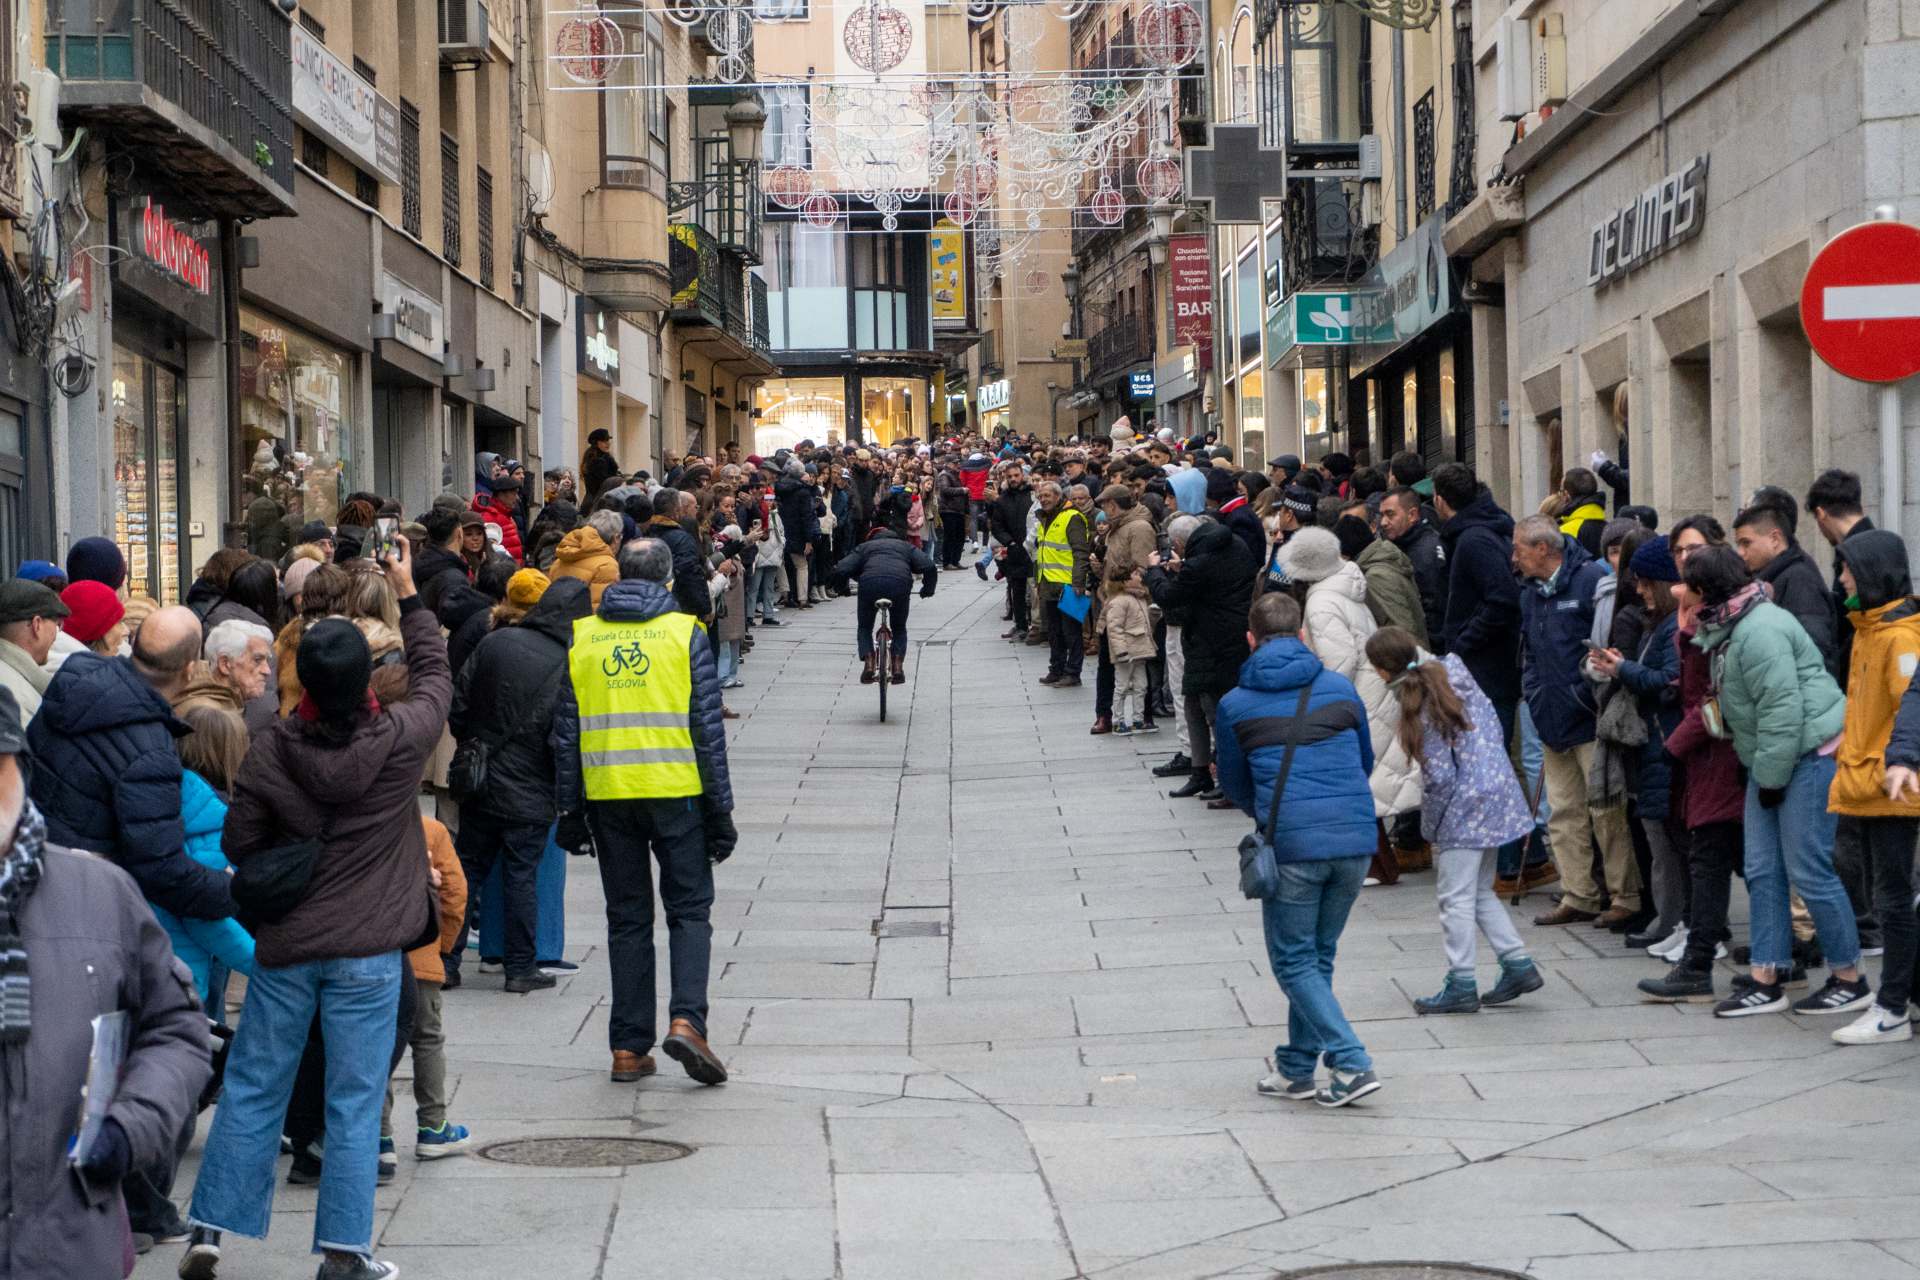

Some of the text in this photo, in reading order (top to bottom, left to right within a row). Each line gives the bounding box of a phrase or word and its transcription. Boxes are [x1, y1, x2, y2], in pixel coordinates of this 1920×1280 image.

[326, 62, 356, 111] DENTAL
[1586, 155, 1707, 287] DECIMAS
[1177, 247, 1208, 255] Chocolate
[1183, 277, 1204, 285] Tapas
[1177, 301, 1213, 316] BAR
[1131, 383, 1155, 391] Change
[591, 631, 617, 644] Escuela
[618, 630, 642, 641] C.D.C.
[607, 679, 647, 690] SEGOVIA
